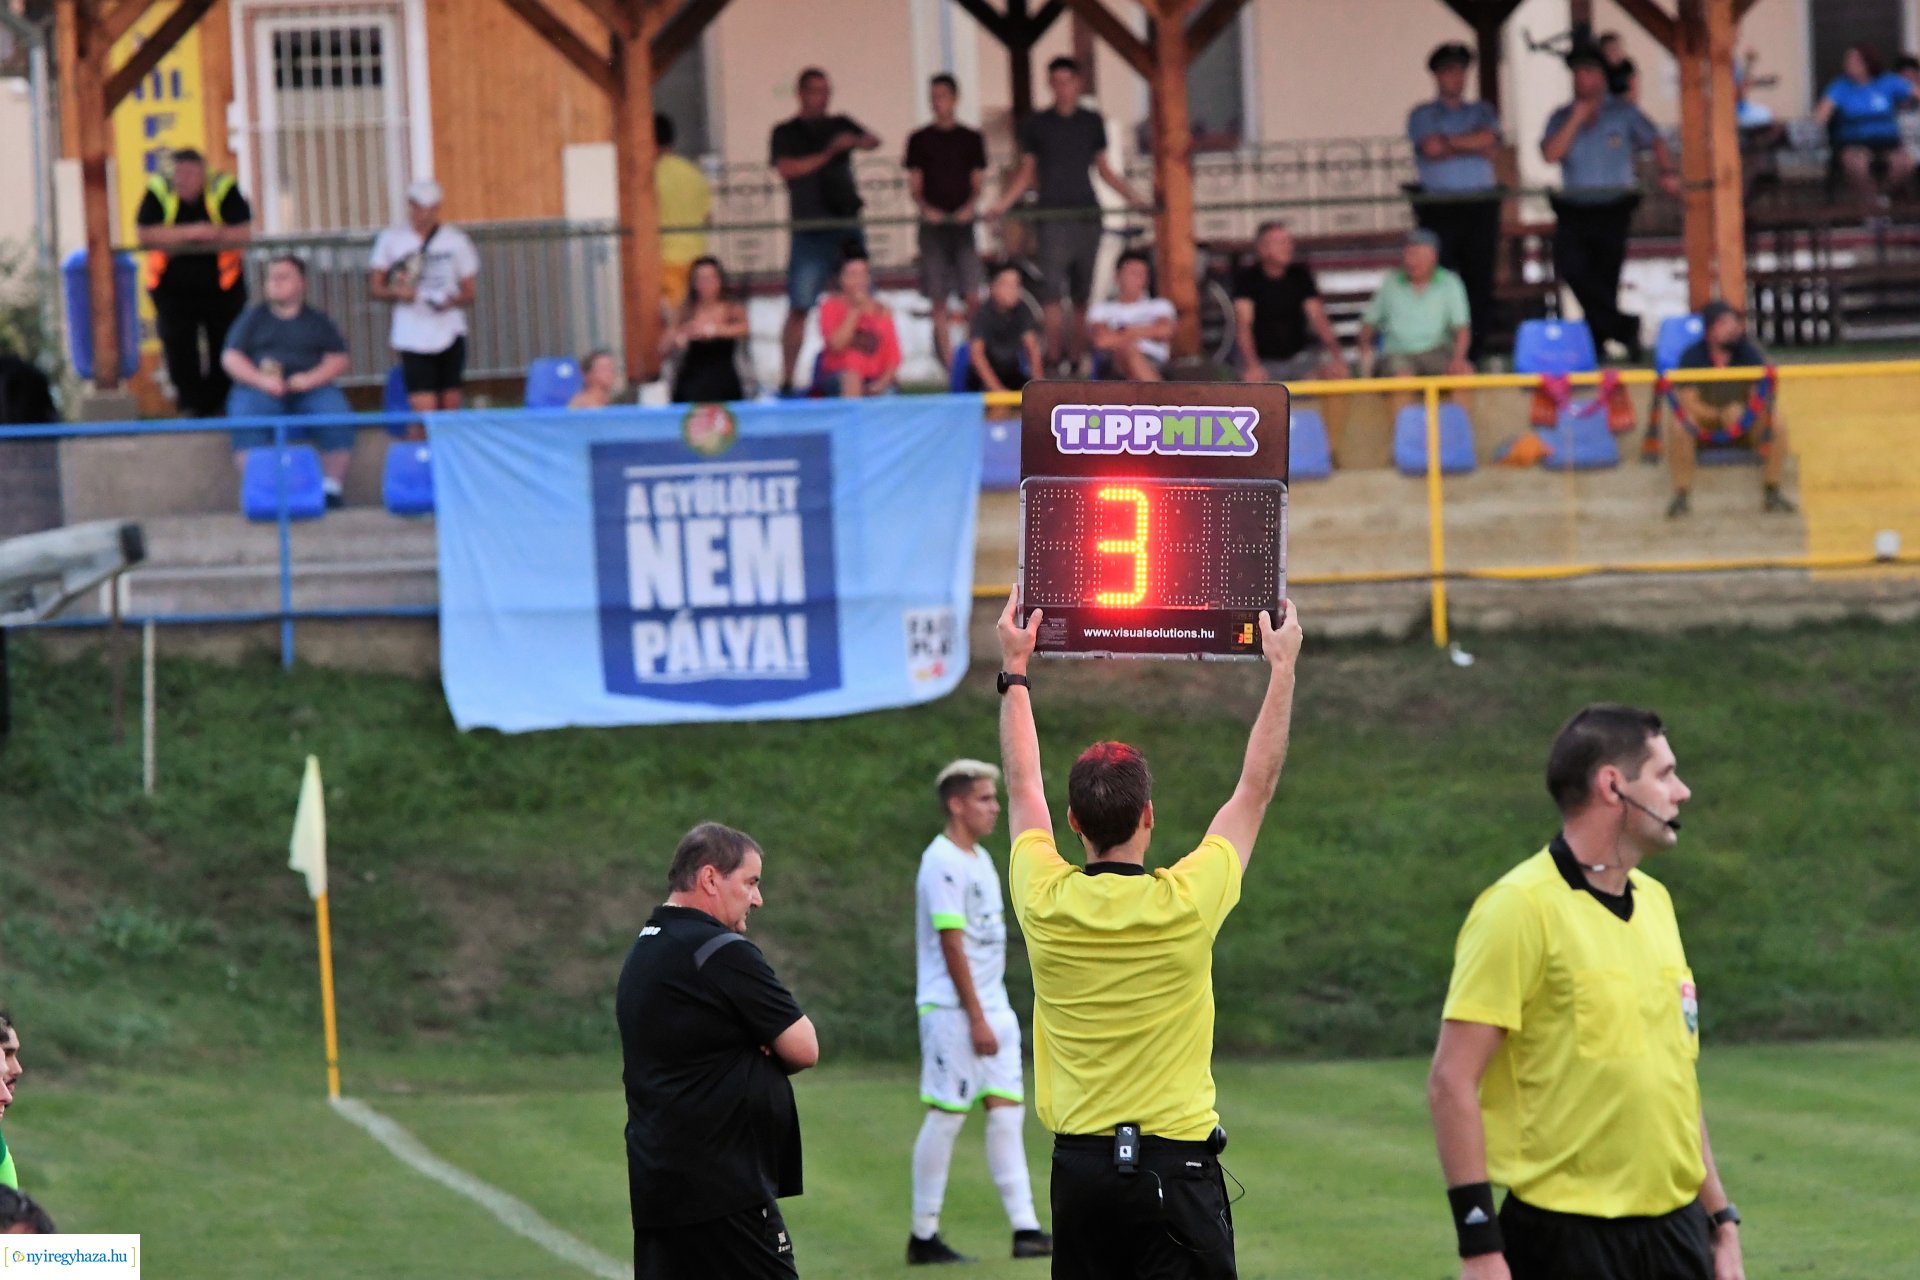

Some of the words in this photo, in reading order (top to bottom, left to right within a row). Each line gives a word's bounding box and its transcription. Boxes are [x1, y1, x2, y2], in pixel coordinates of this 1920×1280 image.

[626, 482, 650, 518] A
[626, 513, 806, 610] NEM
[1096, 487, 1148, 605] 3
[632, 609, 808, 675] PÁLYA!
[1083, 627, 1215, 639] www.visualsolutions.hu
